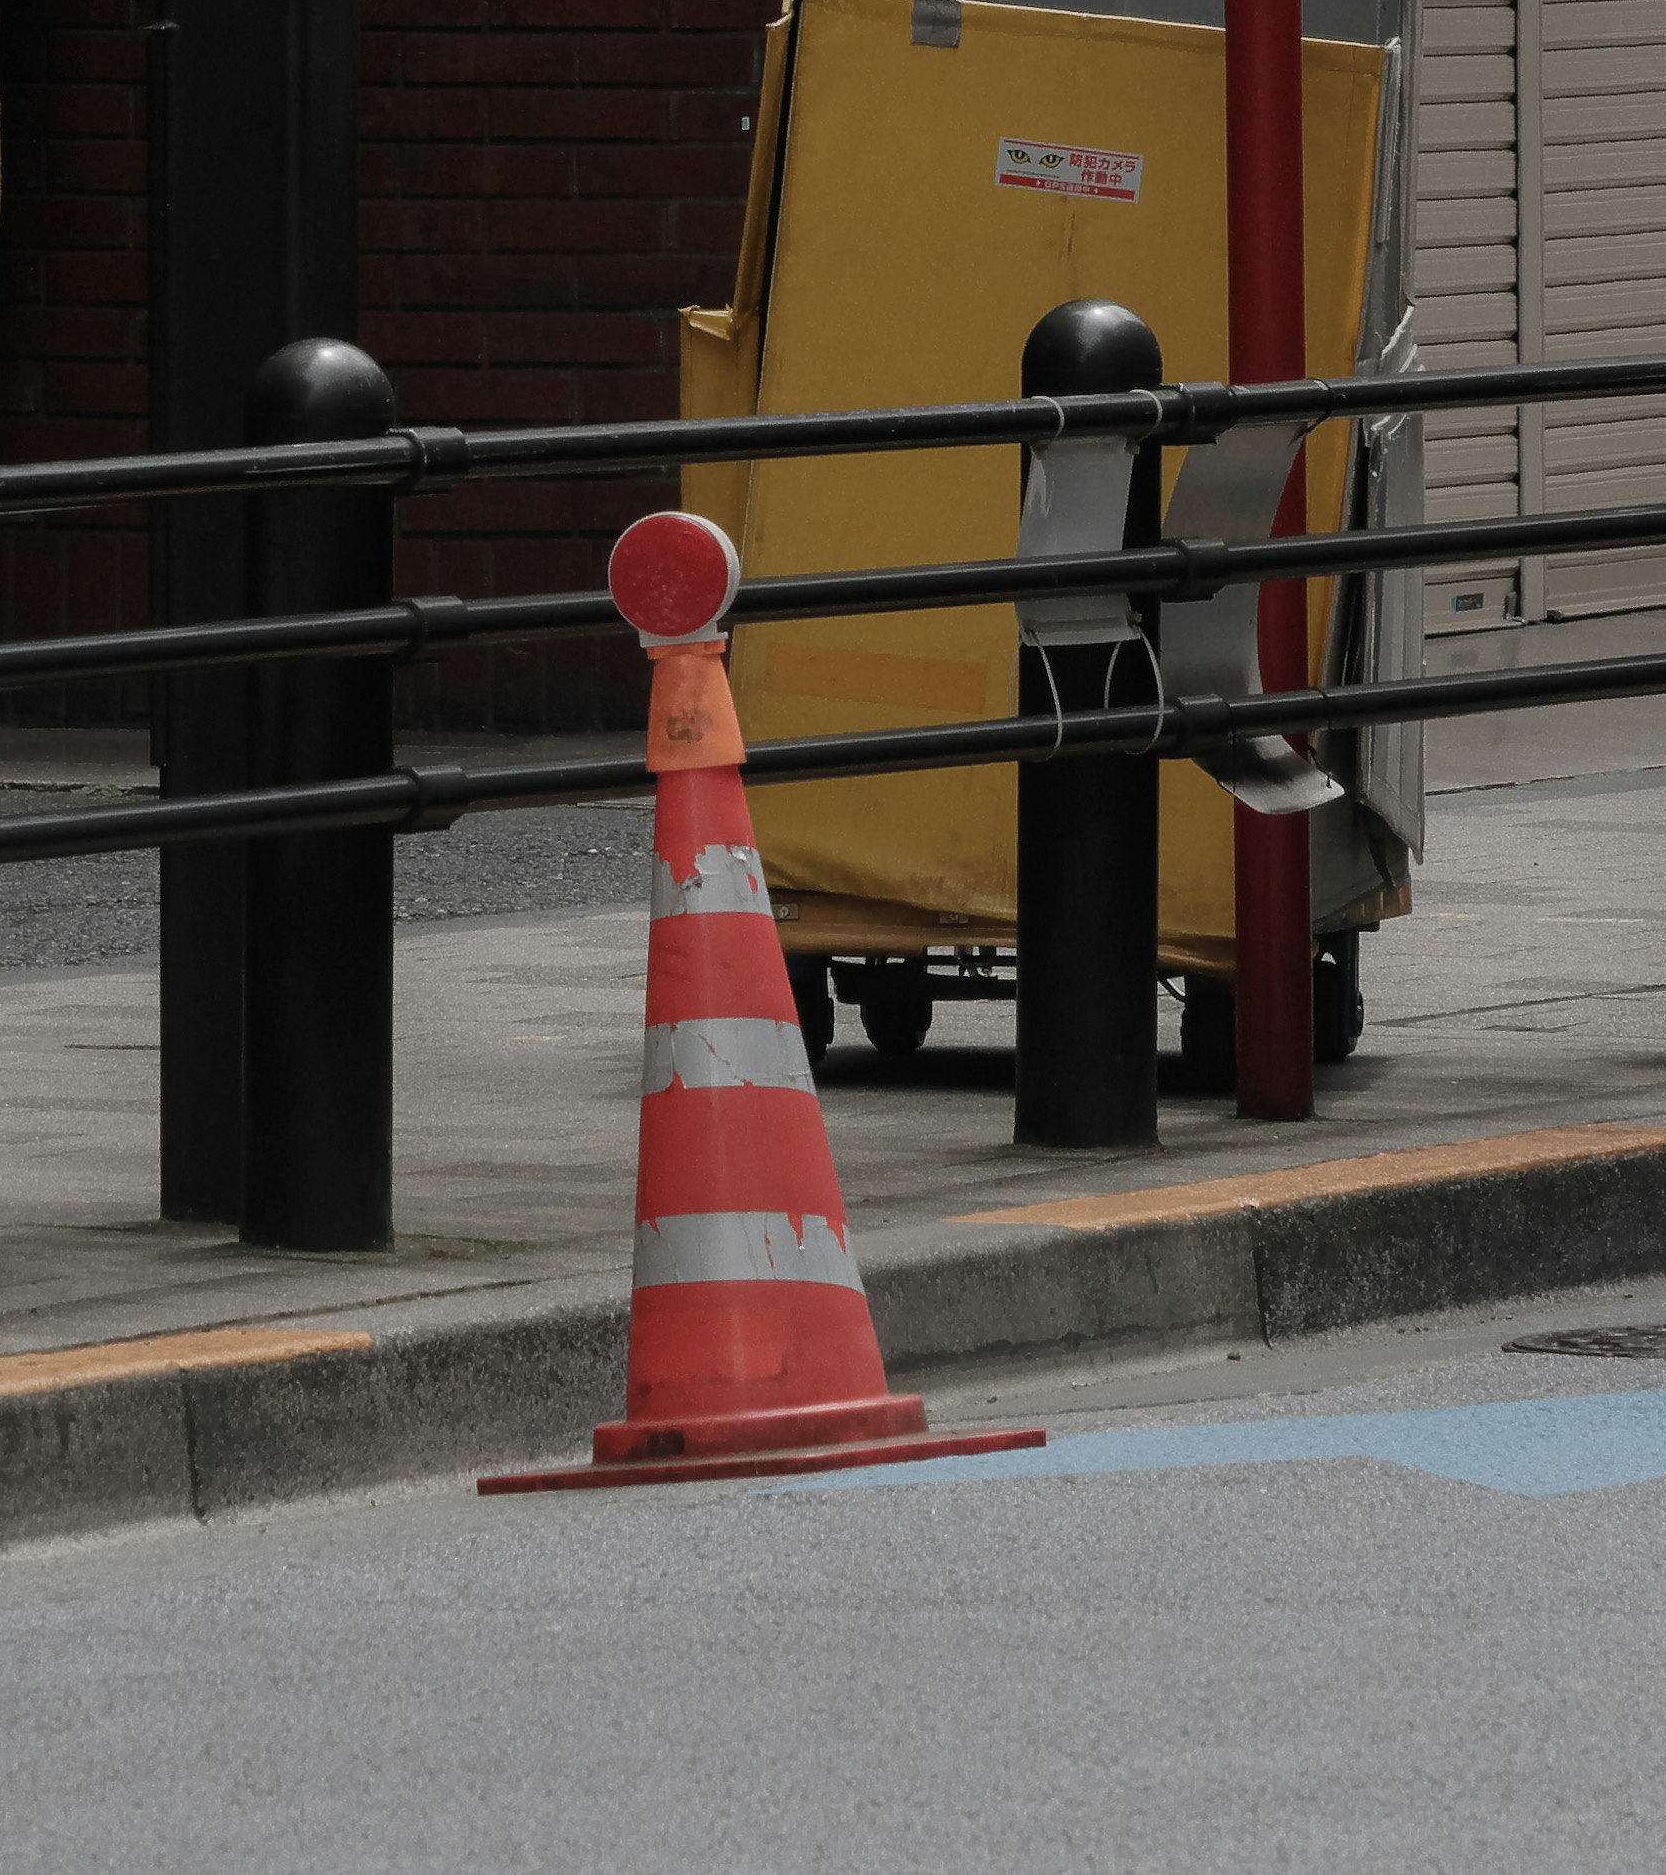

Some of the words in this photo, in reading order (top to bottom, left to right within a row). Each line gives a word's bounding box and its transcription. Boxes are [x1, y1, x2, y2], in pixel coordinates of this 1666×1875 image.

[1068, 153, 1136, 174] 防犯カメラ
[1080, 169, 1122, 186] 作動中
